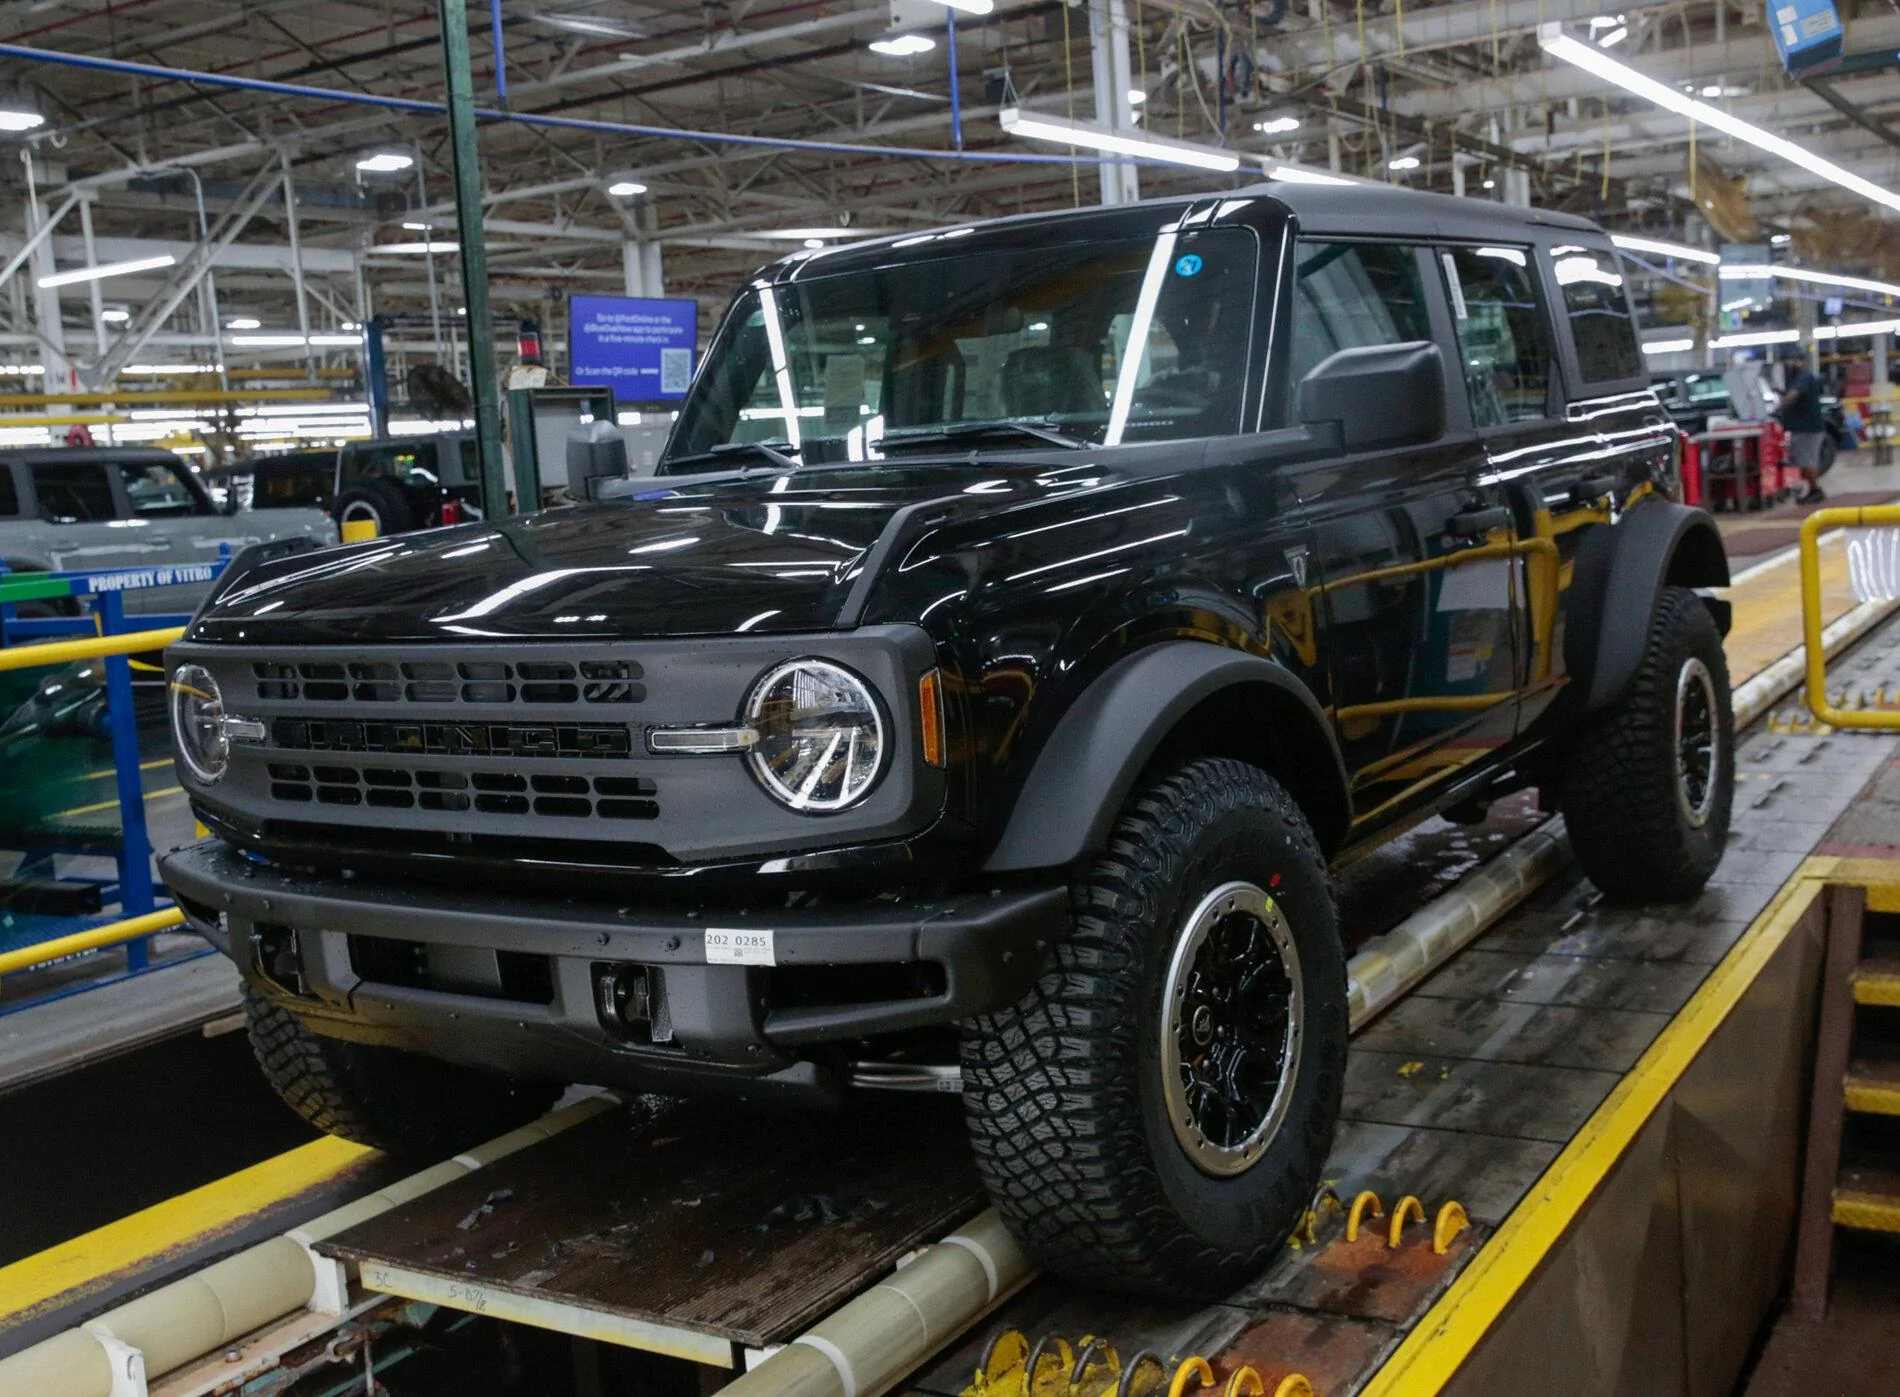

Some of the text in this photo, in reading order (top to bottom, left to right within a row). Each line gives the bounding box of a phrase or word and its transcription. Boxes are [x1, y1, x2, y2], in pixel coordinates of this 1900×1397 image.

[89, 566, 212, 593] PROPERTY OF VITRO
[271, 716, 632, 758] RONCO
[706, 934, 766, 946] 202 0285
